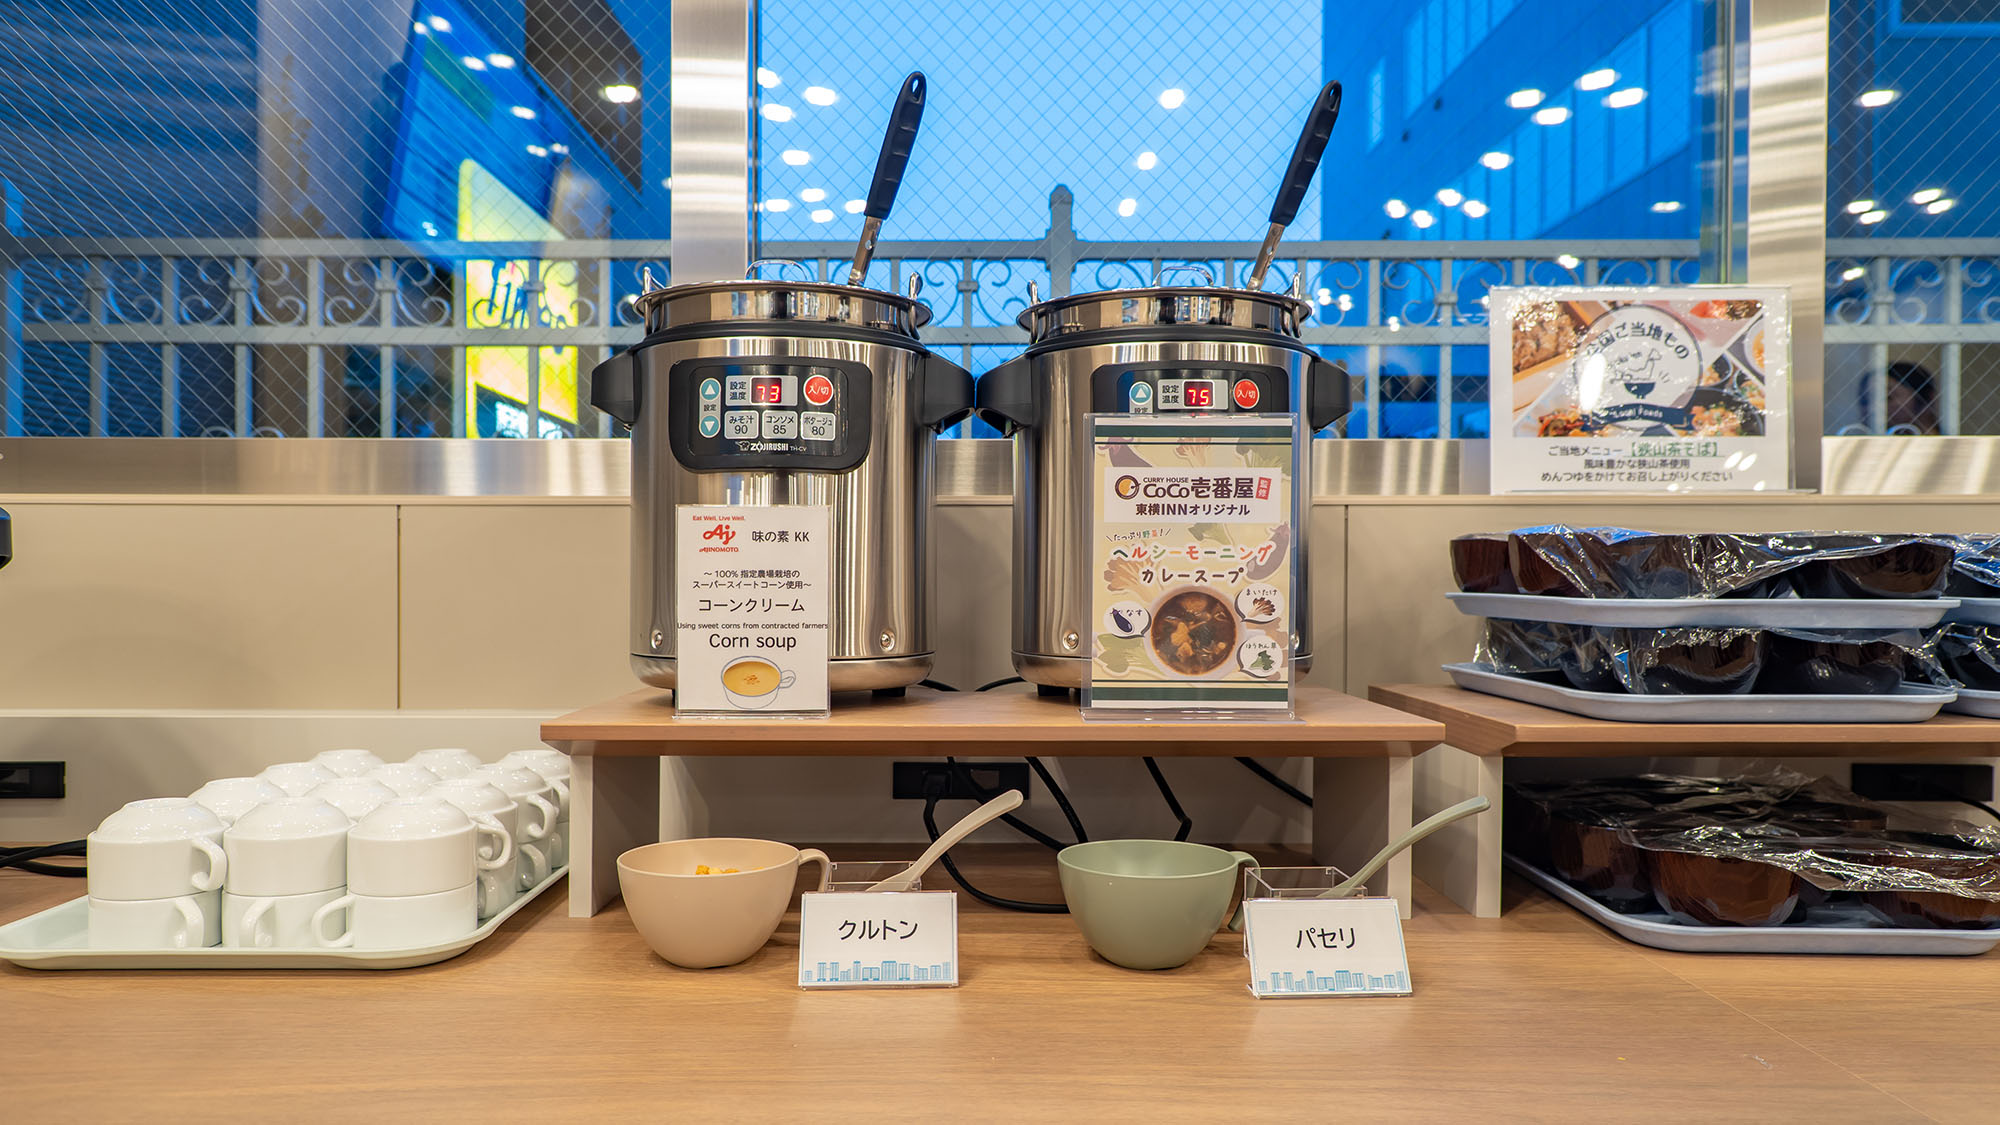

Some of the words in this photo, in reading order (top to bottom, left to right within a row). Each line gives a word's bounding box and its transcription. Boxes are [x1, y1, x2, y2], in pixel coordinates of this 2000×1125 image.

[730, 381, 746, 390] 設定
[808, 385, 829, 395] 入/切
[1162, 385, 1179, 394] 設定
[729, 391, 746, 401] 温度
[756, 385, 780, 402] 73
[1187, 388, 1210, 405] 75
[1236, 390, 1256, 399] 入/切
[1162, 395, 1179, 404] 温度
[703, 404, 717, 412] 設定
[728, 415, 754, 424] みそ汁
[766, 415, 795, 424] コンソメ
[803, 416, 833, 426] ポタージュ
[734, 425, 748, 435] 90
[772, 425, 787, 435] 85
[811, 426, 825, 436] 80
[750, 442, 789, 453] ZOJIRUSHI
[1548, 445, 1622, 457] ご当地メニュー
[1584, 459, 1690, 469] 風味豊かな狭山茶使用
[1541, 471, 1733, 482] めんつゆをかけてお召し上がりください
[1136, 503, 1250, 516] 東横INNオリジナル
[752, 531, 789, 543] 味の素
[794, 532, 810, 542] KK
[1113, 545, 1272, 562] ヘルシーモーニング
[1142, 568, 1244, 583] カレースープ
[699, 599, 805, 612] コーンクリーム
[709, 634, 749, 648] Corn
[756, 636, 797, 651] soup
[838, 919, 918, 940] クルトン
[1296, 927, 1355, 949] パセリ
